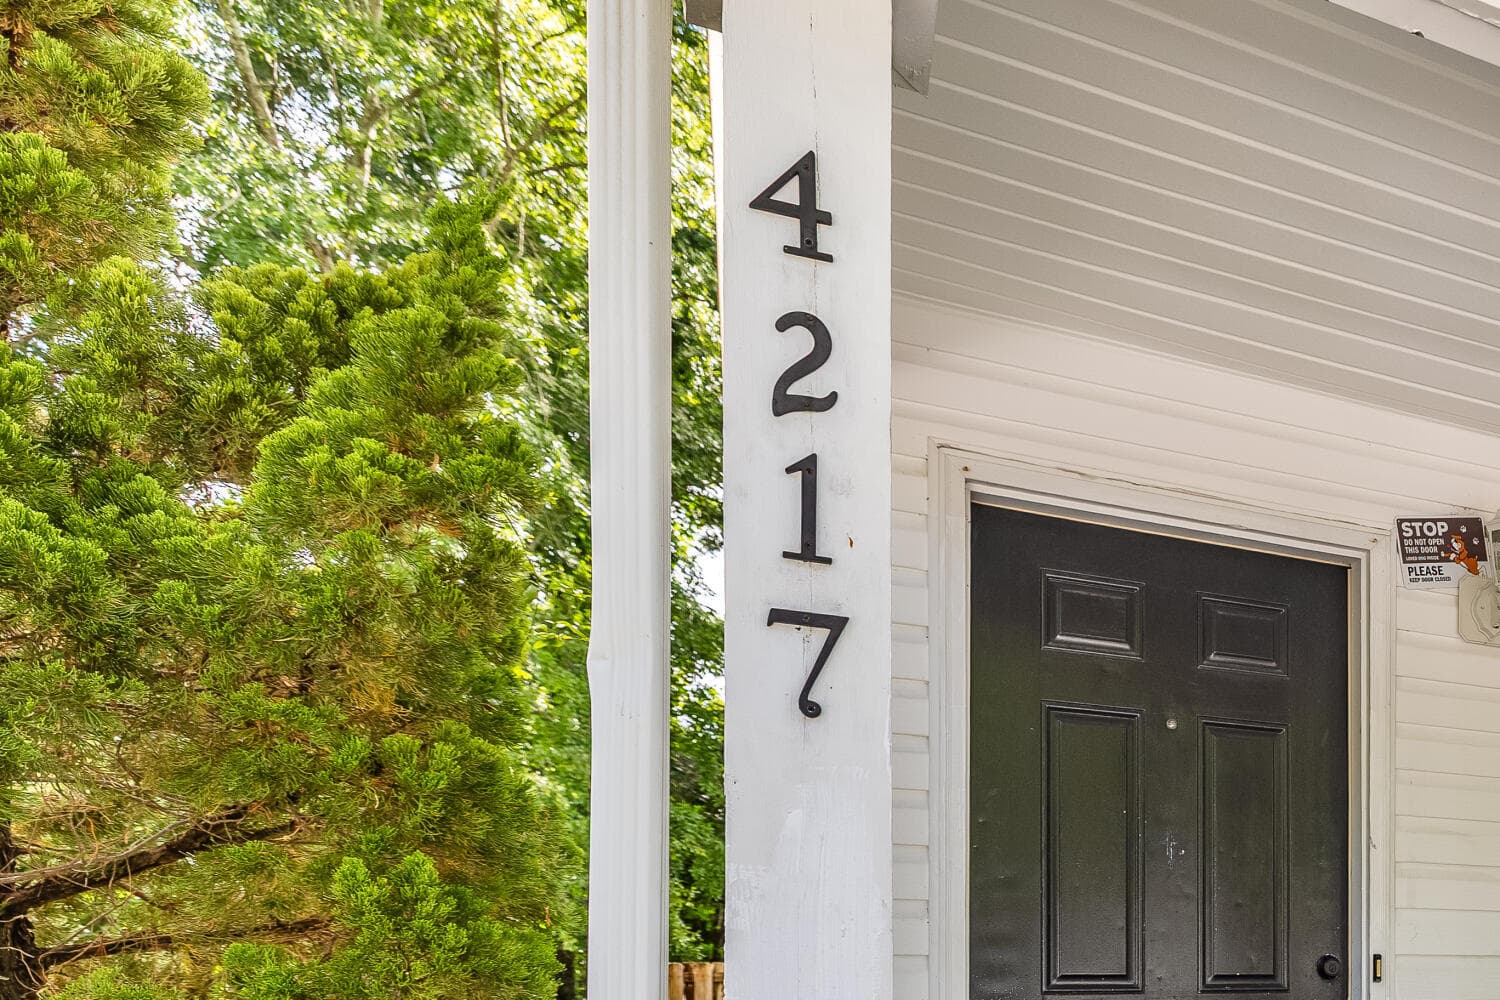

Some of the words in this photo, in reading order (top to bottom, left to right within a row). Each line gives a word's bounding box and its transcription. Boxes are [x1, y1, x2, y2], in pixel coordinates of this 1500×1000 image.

[748, 149, 850, 719] 4217
[1401, 521, 1449, 537] STOP
[1403, 538, 1413, 546] DO
[1405, 546, 1419, 554] THIS
[1408, 566, 1444, 576] PLEASE
